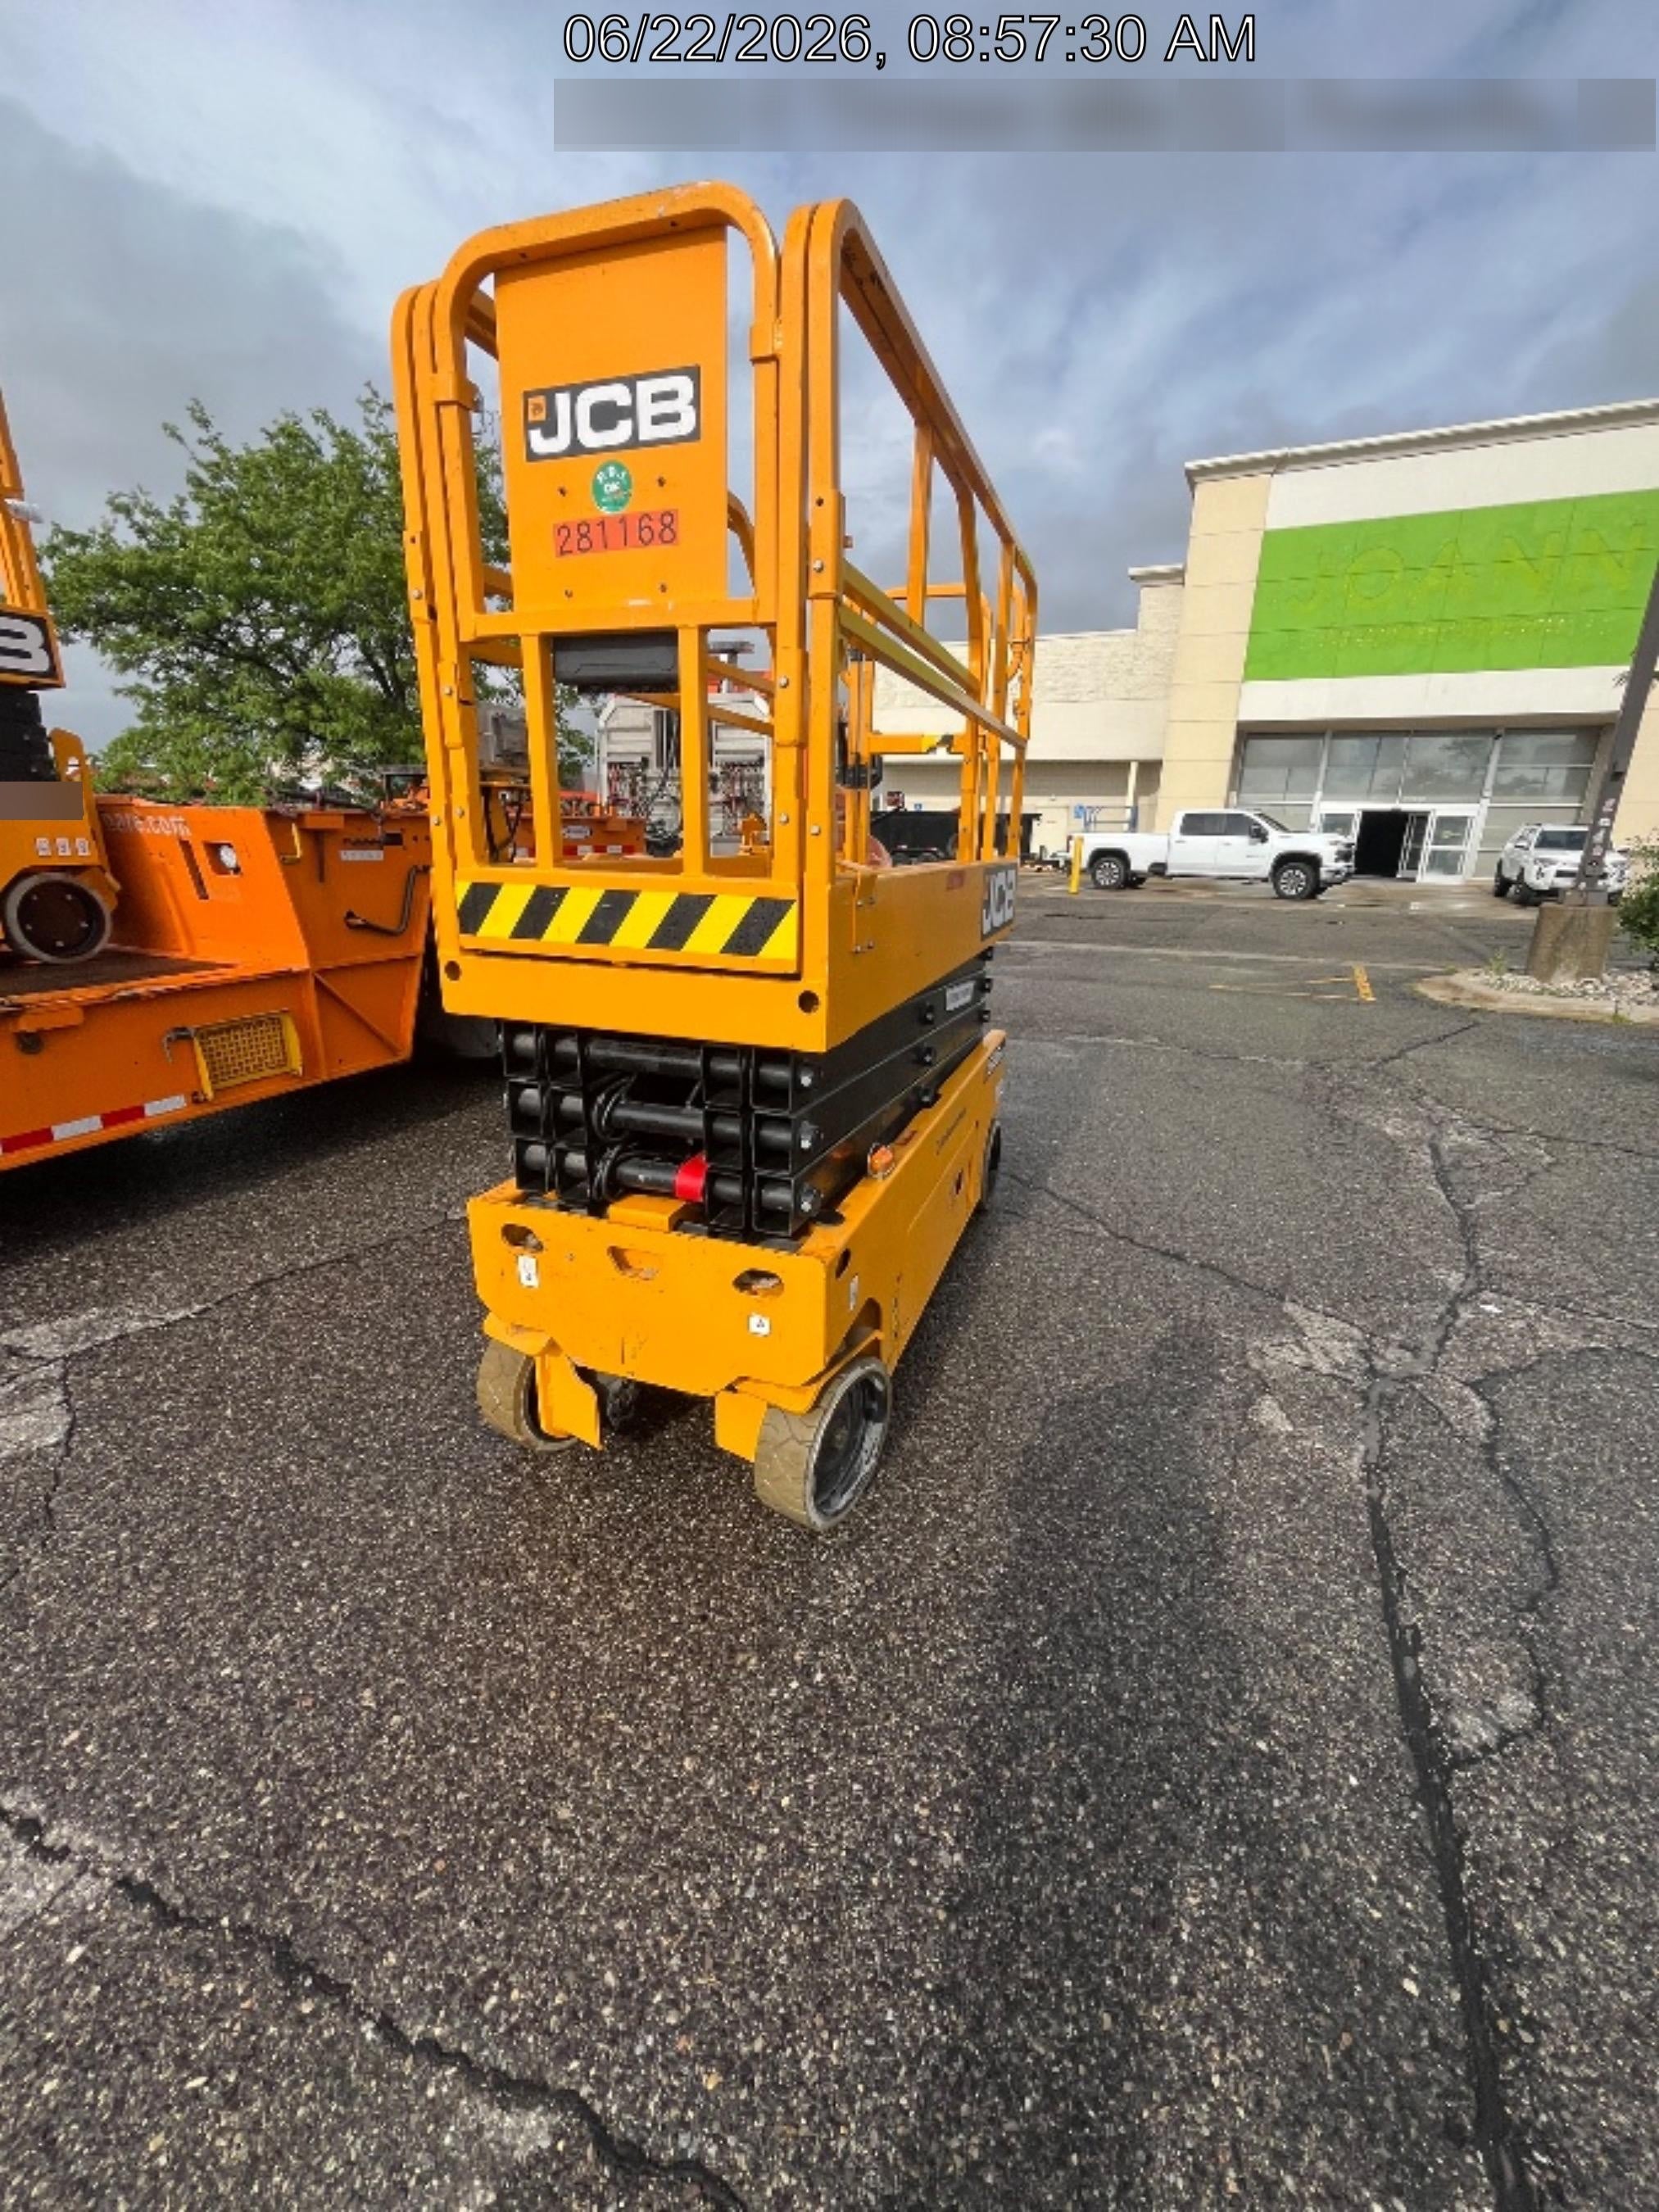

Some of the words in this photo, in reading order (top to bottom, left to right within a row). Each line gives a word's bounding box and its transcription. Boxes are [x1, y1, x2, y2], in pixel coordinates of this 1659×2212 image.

[528, 375, 696, 454] JCB
[556, 510, 677, 556] 281168
[982, 869, 1015, 935] JCB
